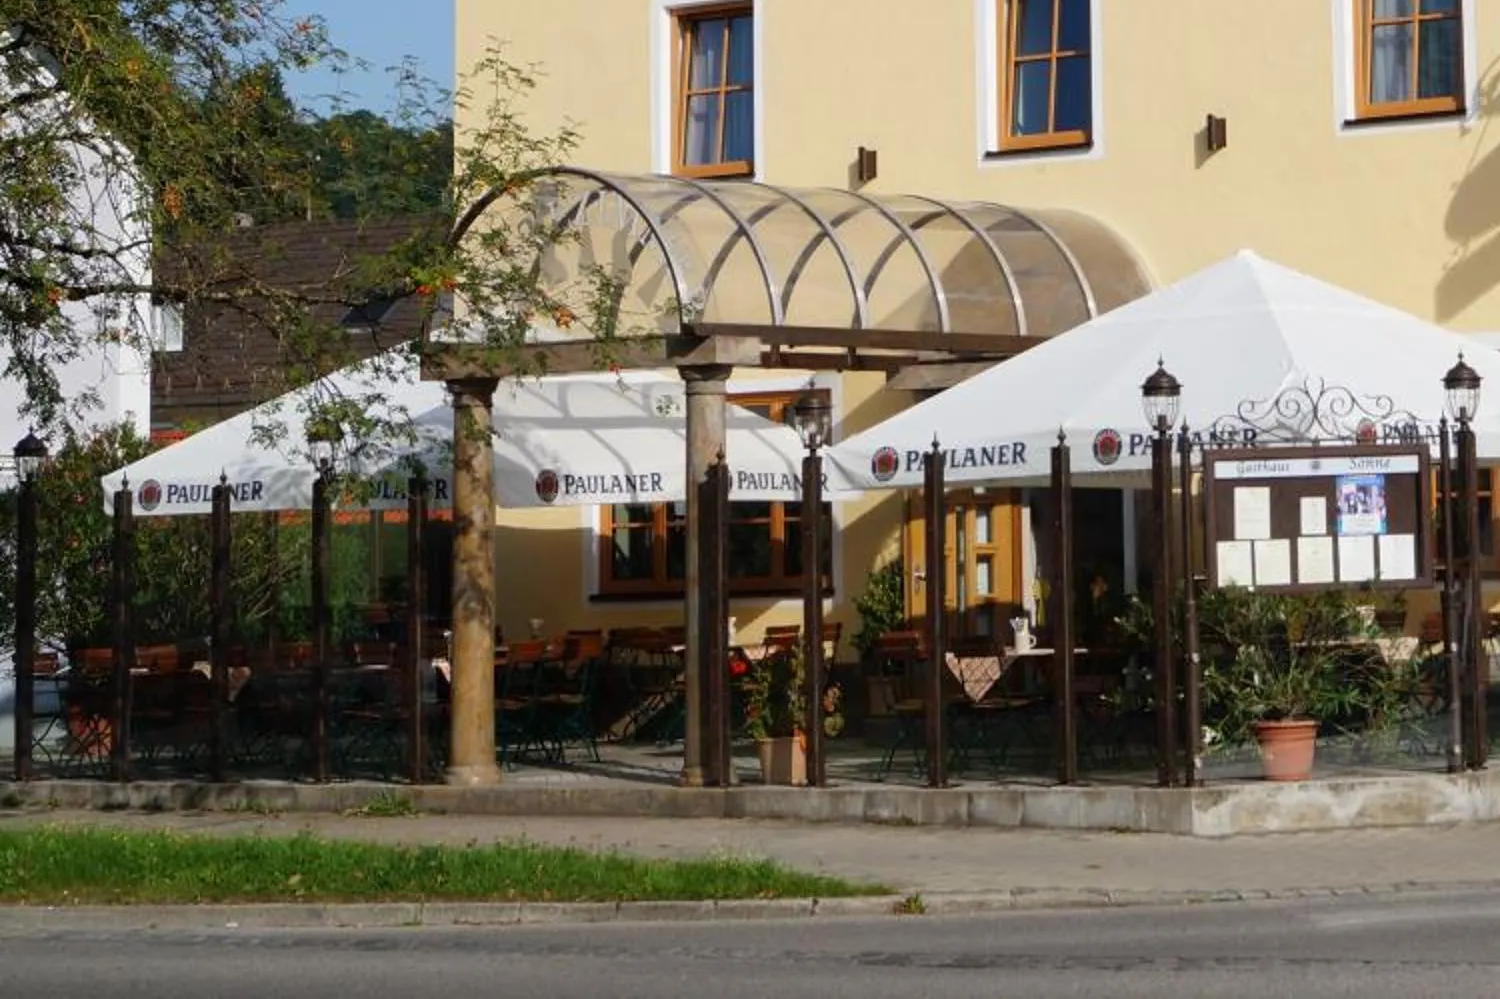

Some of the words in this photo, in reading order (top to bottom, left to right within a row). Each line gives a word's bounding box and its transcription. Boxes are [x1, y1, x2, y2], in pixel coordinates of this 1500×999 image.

[166, 480, 263, 504] PAULNER
[564, 472, 666, 495] PAULANER
[737, 470, 829, 492] PAULANR
